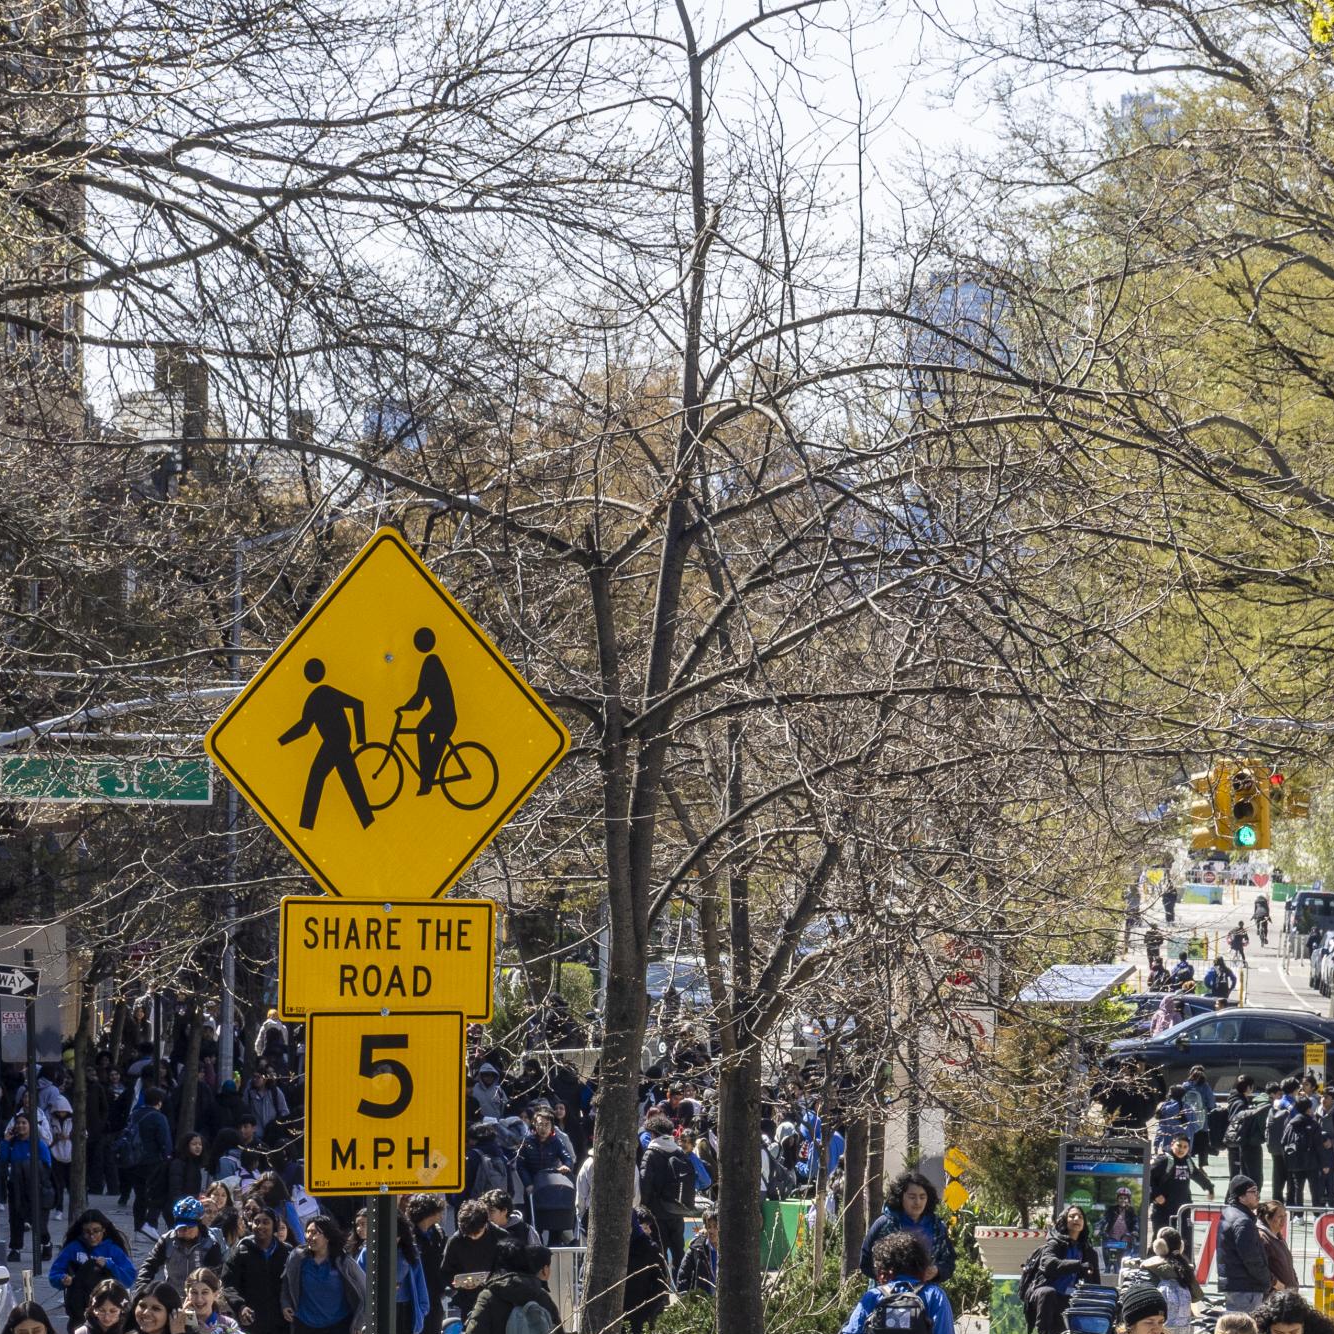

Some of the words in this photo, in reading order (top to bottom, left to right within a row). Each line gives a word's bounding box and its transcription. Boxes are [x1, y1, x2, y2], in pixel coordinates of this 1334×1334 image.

[303, 916, 402, 950] SHARE
[417, 918, 472, 951] THE
[339, 964, 432, 998] ROAD
[357, 1033, 414, 1119] 5
